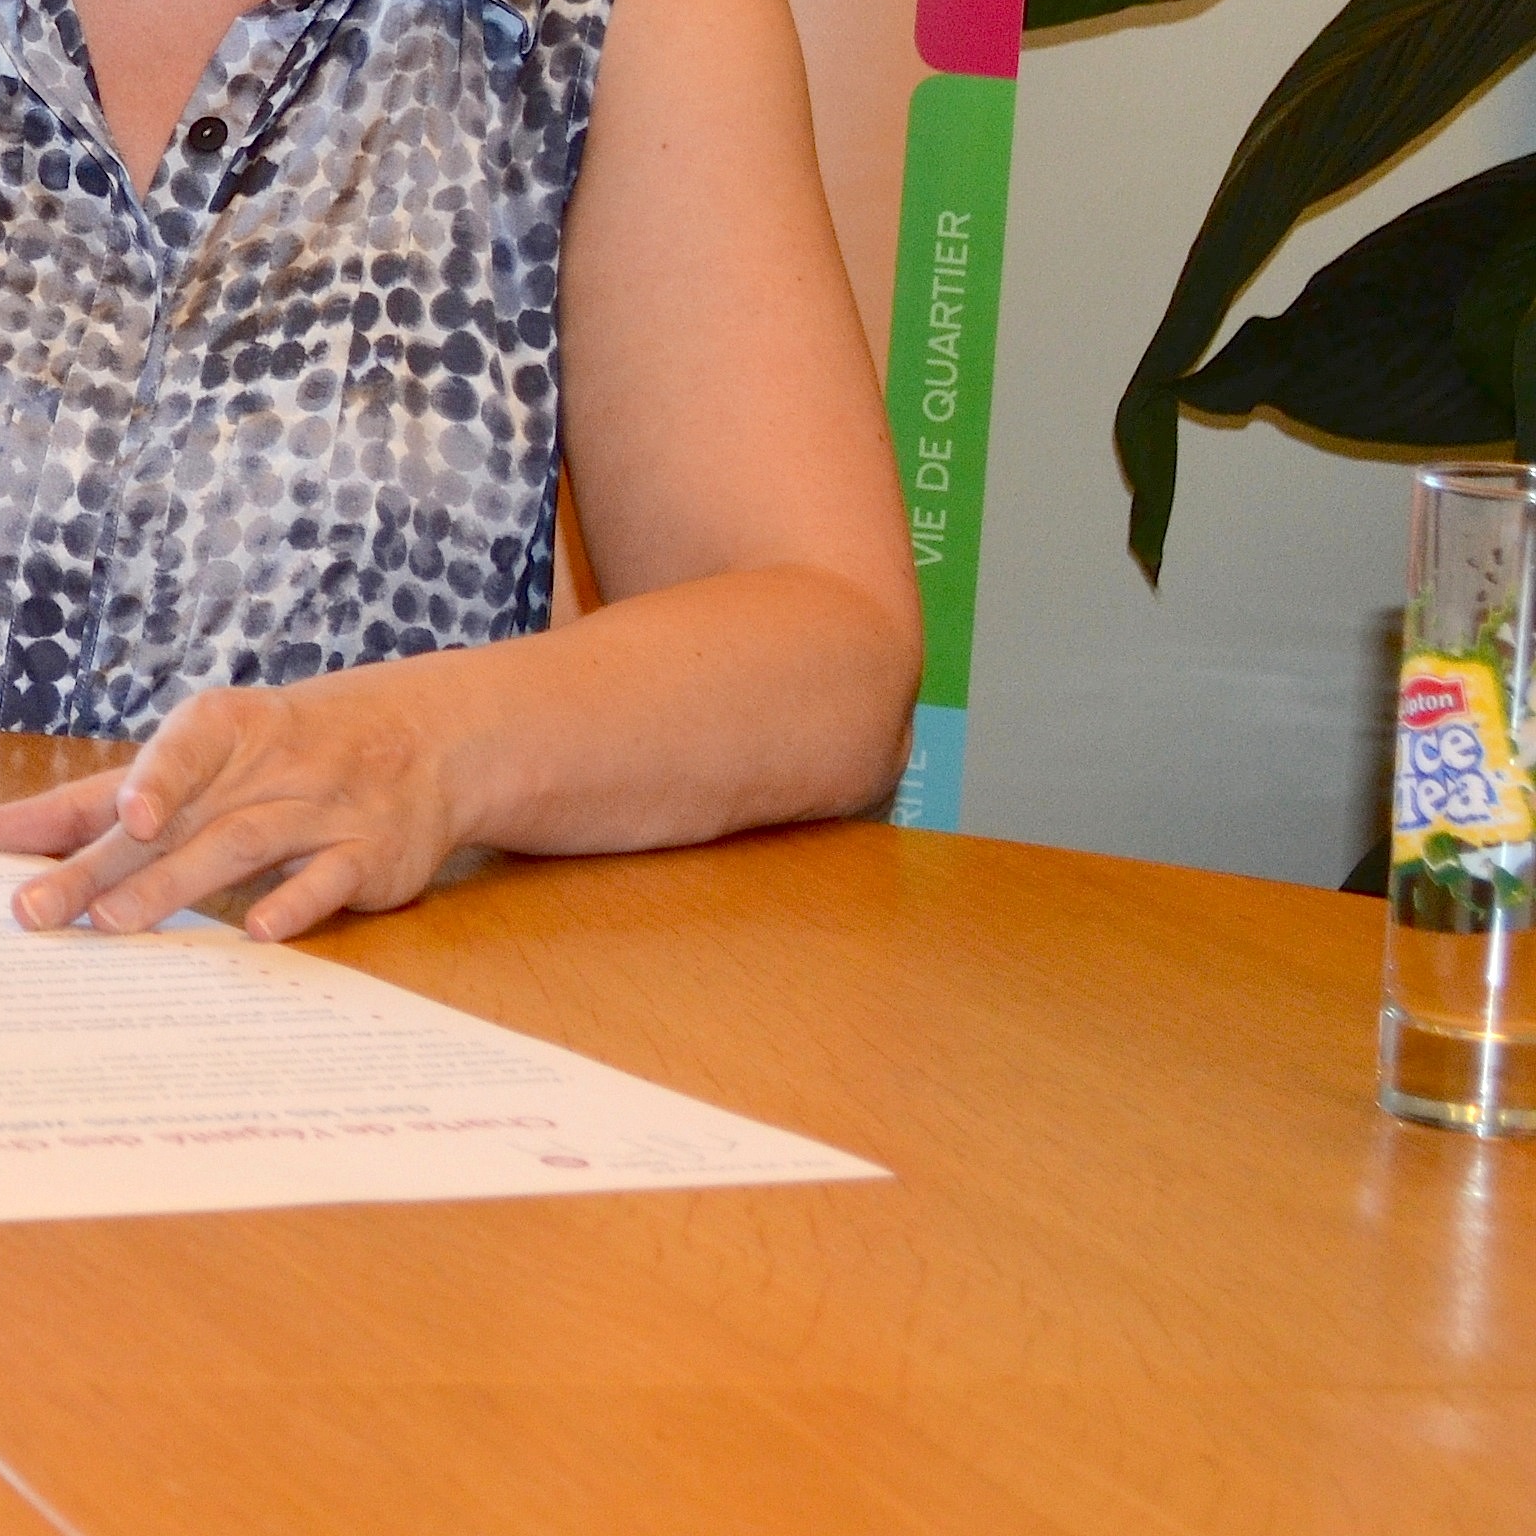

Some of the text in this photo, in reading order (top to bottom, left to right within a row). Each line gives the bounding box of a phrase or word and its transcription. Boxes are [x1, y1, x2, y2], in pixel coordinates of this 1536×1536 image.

[913, 211, 972, 567] VIE DE QUARTIER
